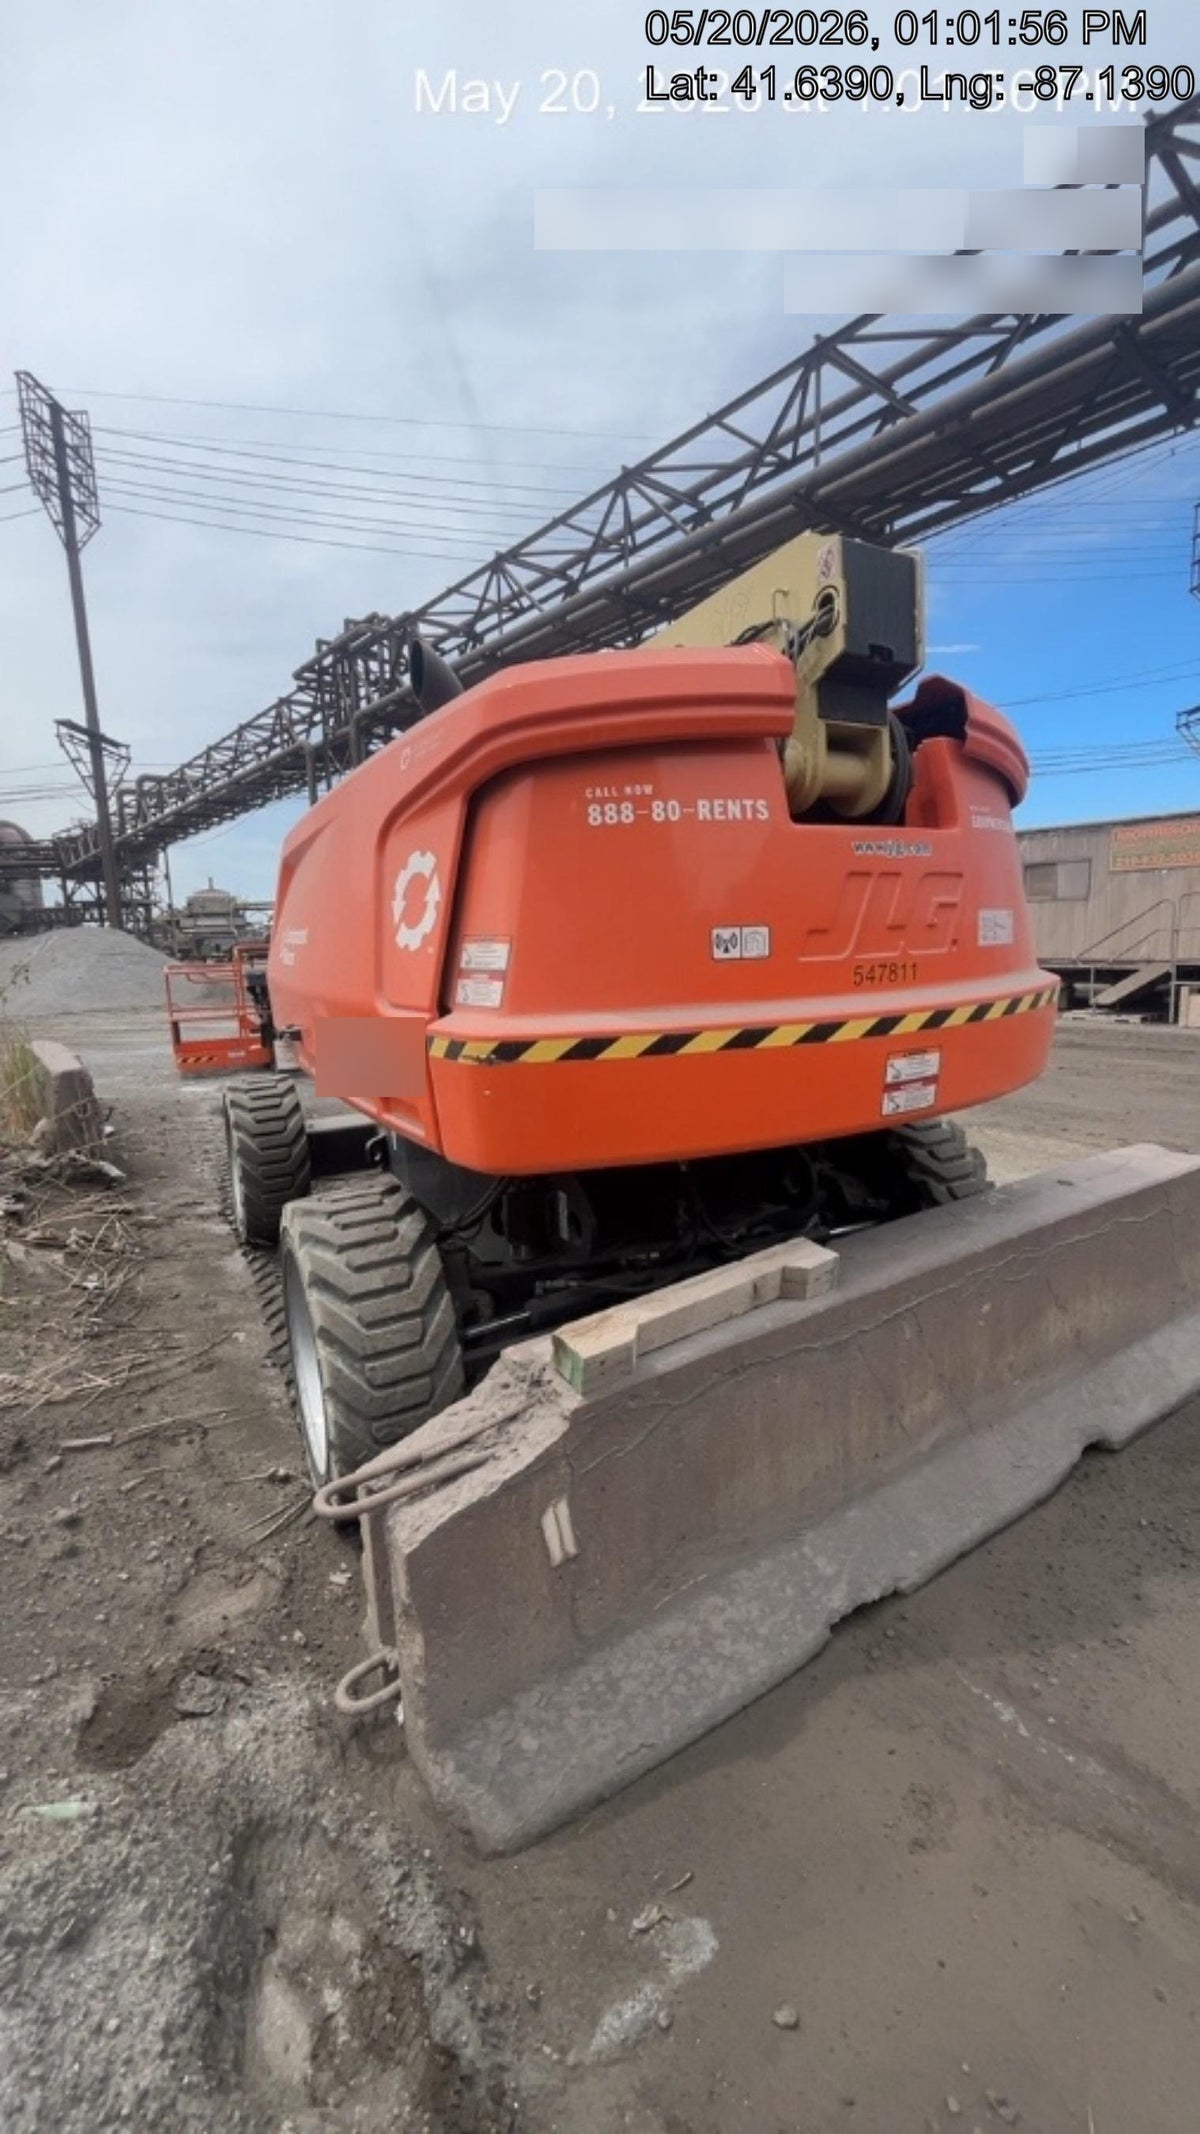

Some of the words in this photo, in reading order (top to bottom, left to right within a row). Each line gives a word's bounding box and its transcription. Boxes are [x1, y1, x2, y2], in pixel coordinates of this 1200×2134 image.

[584, 786, 618, 799] CALL
[624, 784, 654, 796] NOW
[587, 799, 769, 826] 888-80-RENTS
[853, 962, 918, 987] 547811
